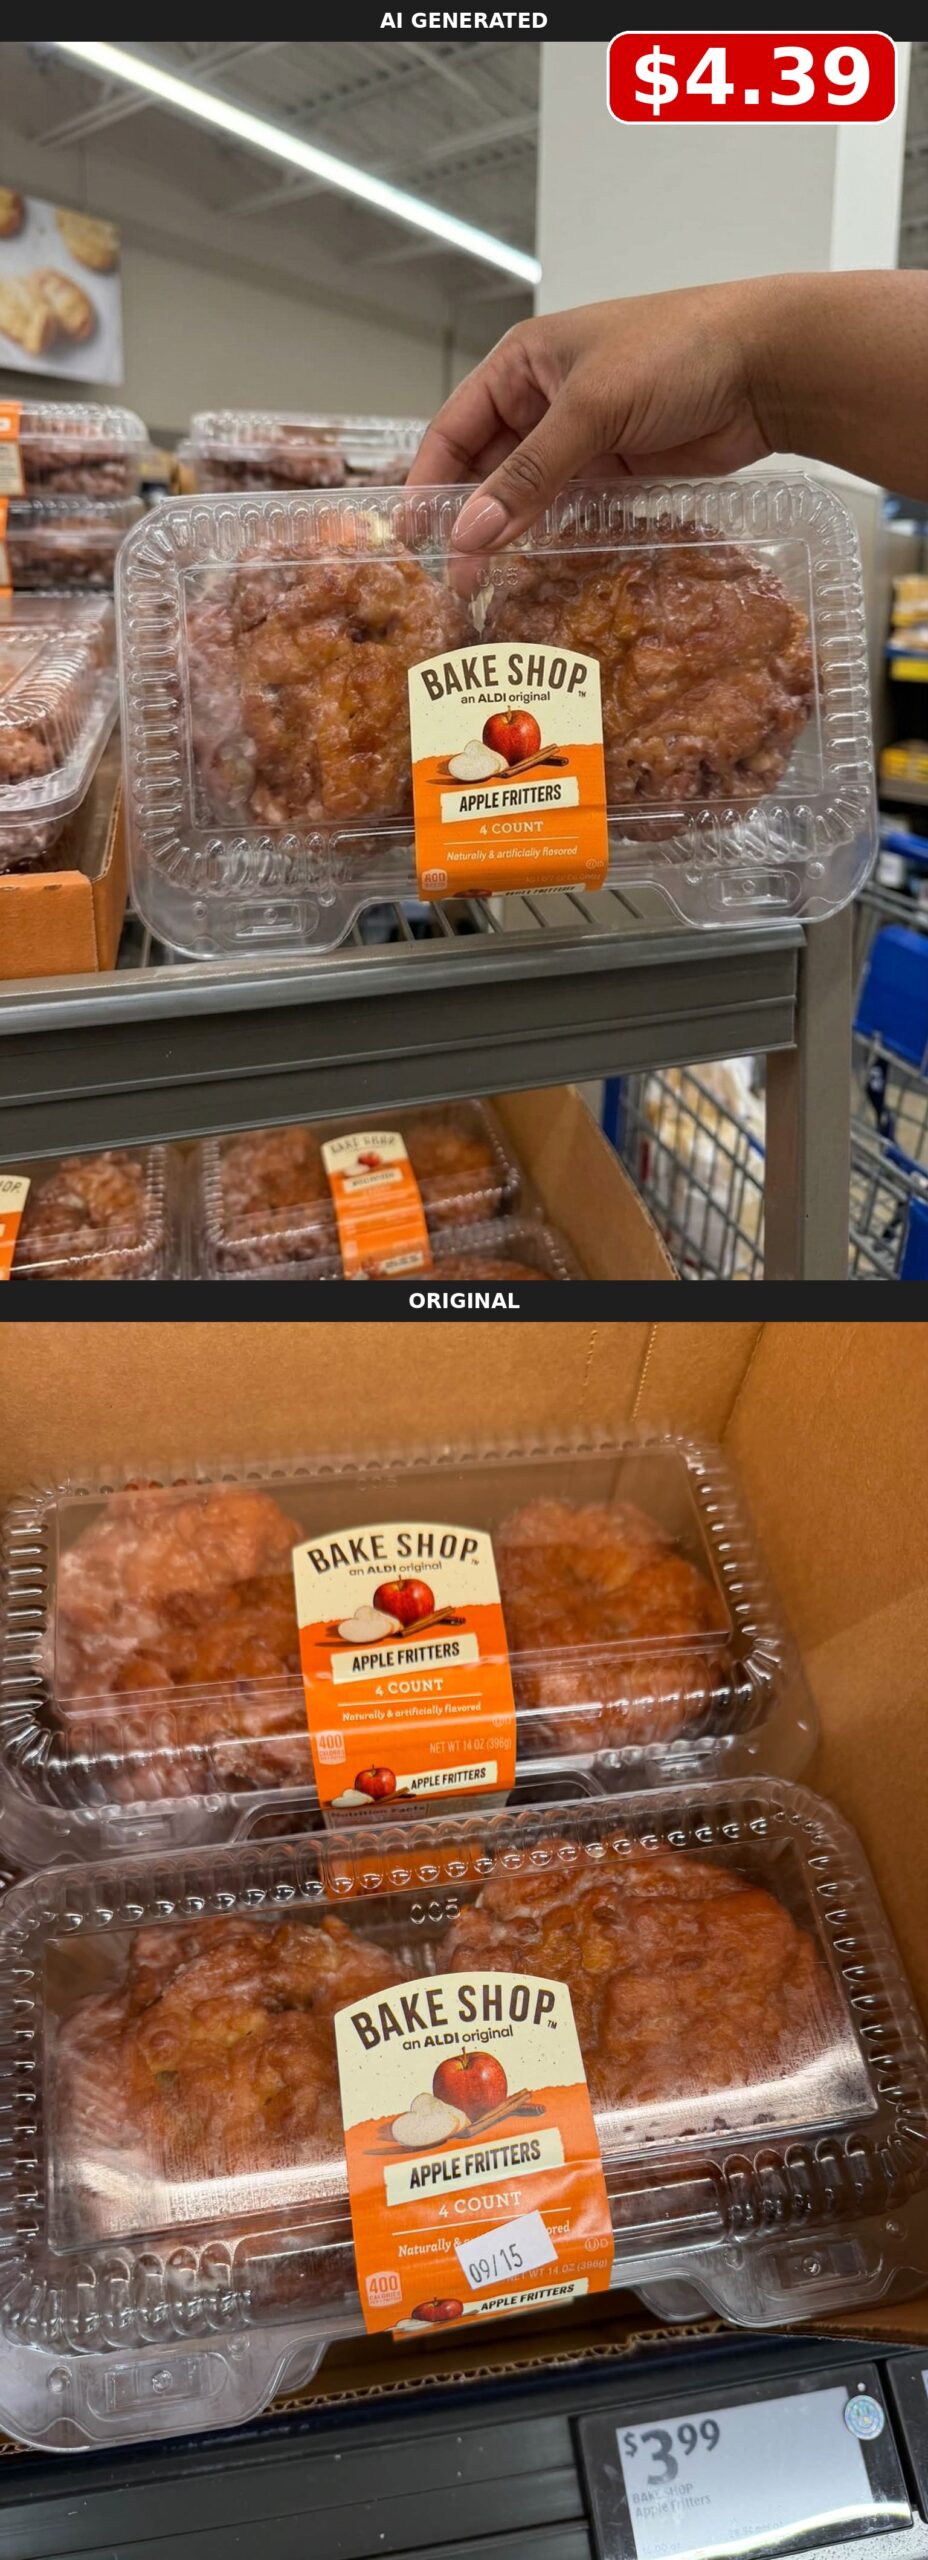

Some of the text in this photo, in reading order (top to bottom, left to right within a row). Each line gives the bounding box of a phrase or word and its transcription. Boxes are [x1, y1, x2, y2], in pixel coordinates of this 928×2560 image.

[421, 654, 499, 701] BAKE
[507, 653, 588, 694] SHOP
[461, 691, 551, 705] an ALDI original
[459, 784, 562, 813] APPLE FRITTERS
[479, 821, 544, 836] 4 COUNT
[447, 850, 487, 863] Naturally
[488, 850, 496, 860] &
[307, 1534, 388, 1574] BAKE
[397, 1532, 478, 1564] SHOP
[349, 1561, 442, 1577] an ALDI original
[352, 1642, 460, 1673] APPLE FRITTERS
[375, 1679, 444, 1697] 4 COUNT
[342, 1702, 481, 1723] Naturally & artificially flavored
[319, 1735, 343, 1749] 400
[430, 1737, 512, 1754] NET WT 14 OZ (396g)
[411, 1768, 487, 1791] APPLE FRITTERS
[410, 1898, 461, 1925] 005
[350, 1988, 448, 2050] BAKE
[458, 1984, 556, 2026] SHOP
[402, 2025, 514, 2051] an ALDI original
[409, 2139, 541, 2190] APPLE FRITTERS
[438, 2191, 522, 2218] 4 COUNT
[398, 2236, 451, 2258] Naturally
[453, 2237, 463, 2248] &
[468, 2243, 524, 2284] 09/15
[529, 2267, 544, 2278] WT
[369, 2275, 399, 2294] 400
[481, 2284, 575, 2311] APPLE FRITTERS
